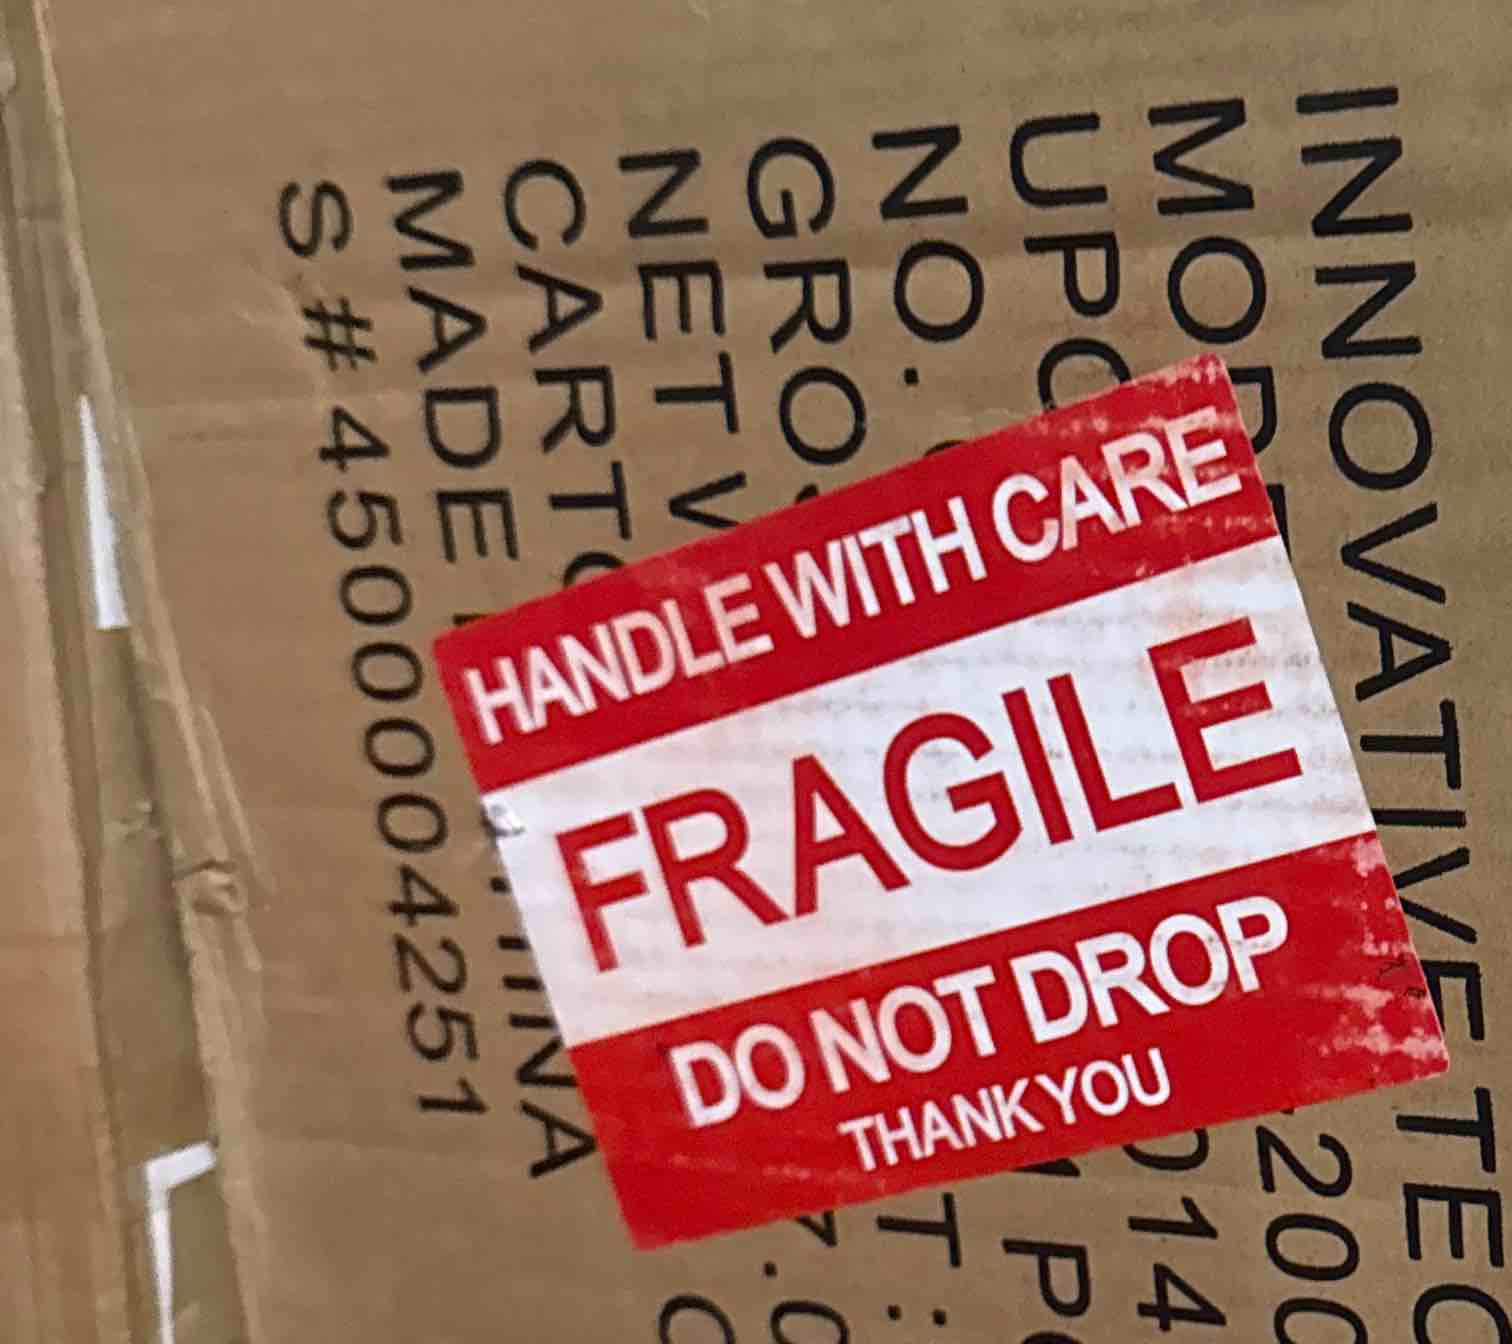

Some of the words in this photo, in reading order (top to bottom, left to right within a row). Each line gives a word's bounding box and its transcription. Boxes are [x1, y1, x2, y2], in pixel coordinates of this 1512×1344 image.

[276, 179, 353, 259] S
[300, 298, 376, 372] #
[617, 146, 740, 434] NET
[870, 122, 985, 386] NO.
[1008, 112, 1133, 409] UPC
[385, 169, 520, 565] MADE
[467, 577, 776, 746] HANDLE
[769, 499, 988, 640] WITH
[993, 405, 1241, 563] CARE
[1296, 86, 1486, 1041] INNOVATIVE
[316, 405, 489, 1117] 4500004251
[557, 617, 1302, 973] FRAGILE
[669, 1023, 805, 1131] DO
[811, 967, 996, 1095] NOT
[1012, 894, 1289, 1045] DROP
[840, 1083, 1040, 1173] THANK
[1040, 1049, 1171, 1135] YOU
